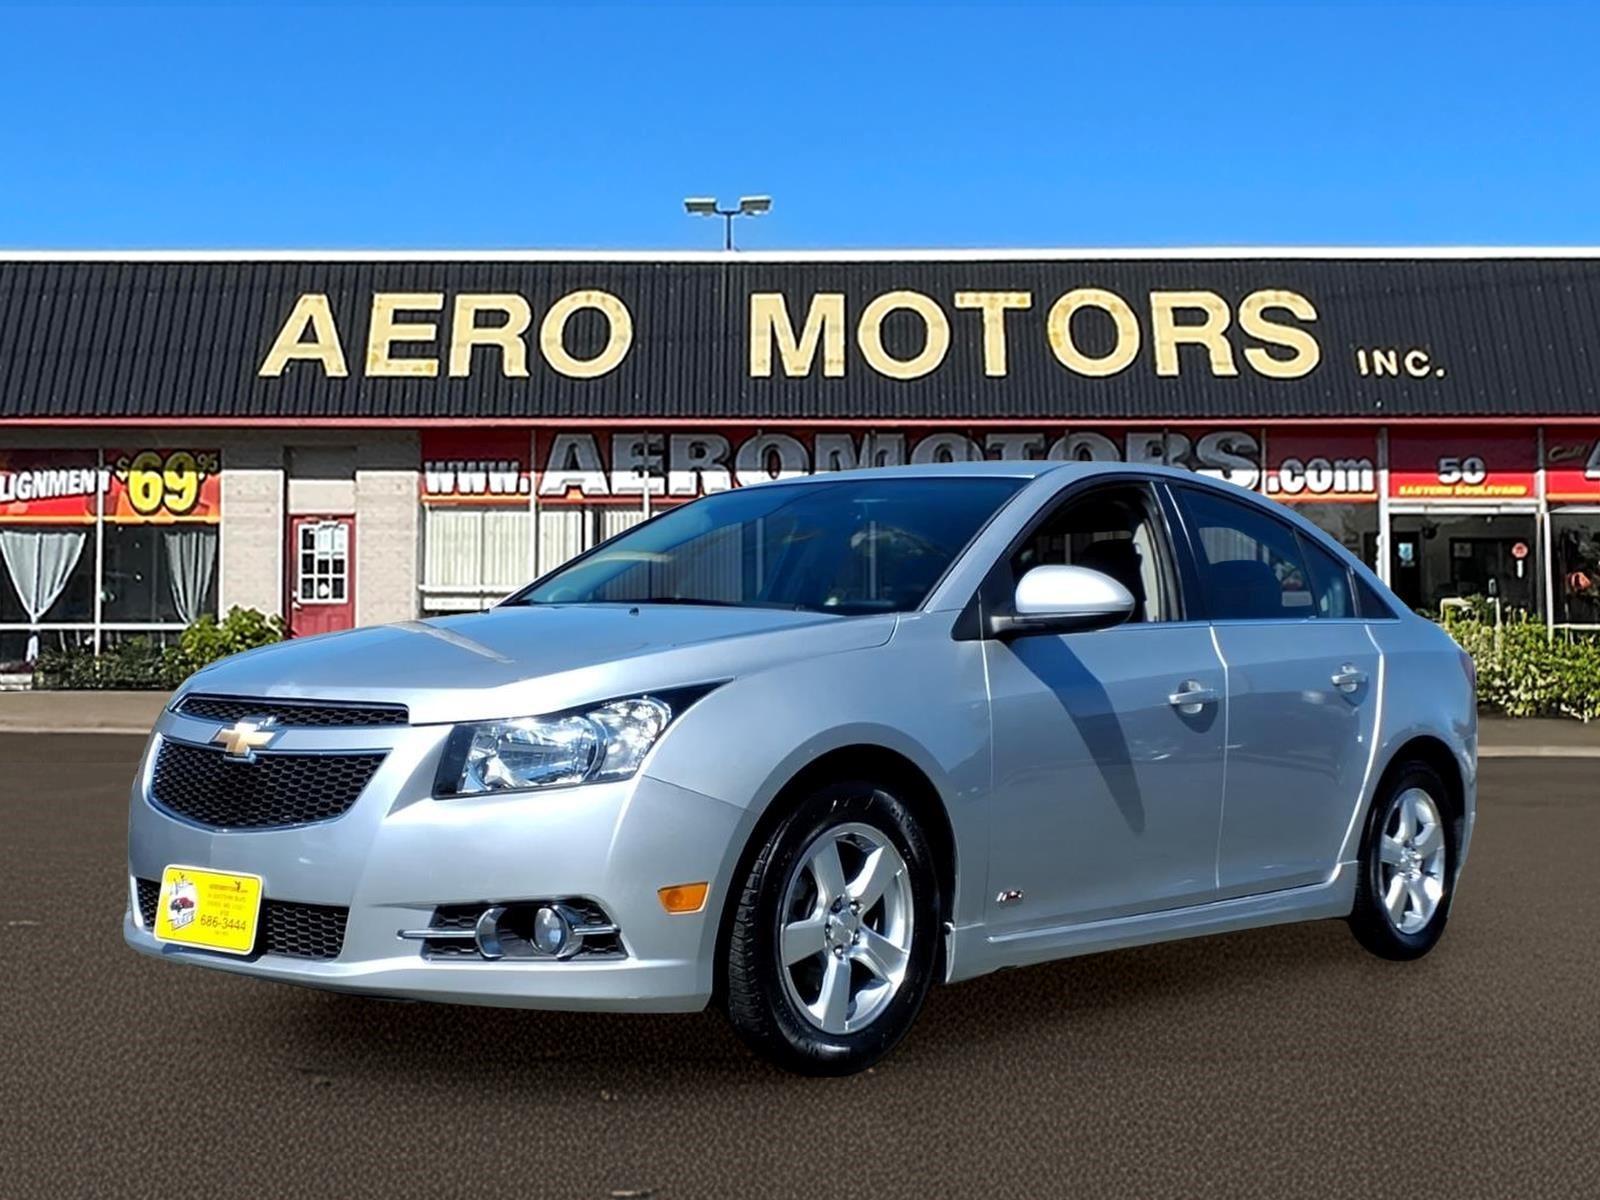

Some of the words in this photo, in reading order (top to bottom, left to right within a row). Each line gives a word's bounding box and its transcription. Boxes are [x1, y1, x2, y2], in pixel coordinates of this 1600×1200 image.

[258, 289, 633, 378] AERO
[750, 289, 1320, 378] MOTORS
[1357, 349, 1446, 378] INC.
[0, 468, 110, 501] LIGNMENT
[1438, 457, 1486, 484] 50
[200, 914, 247, 930] 686-3444
